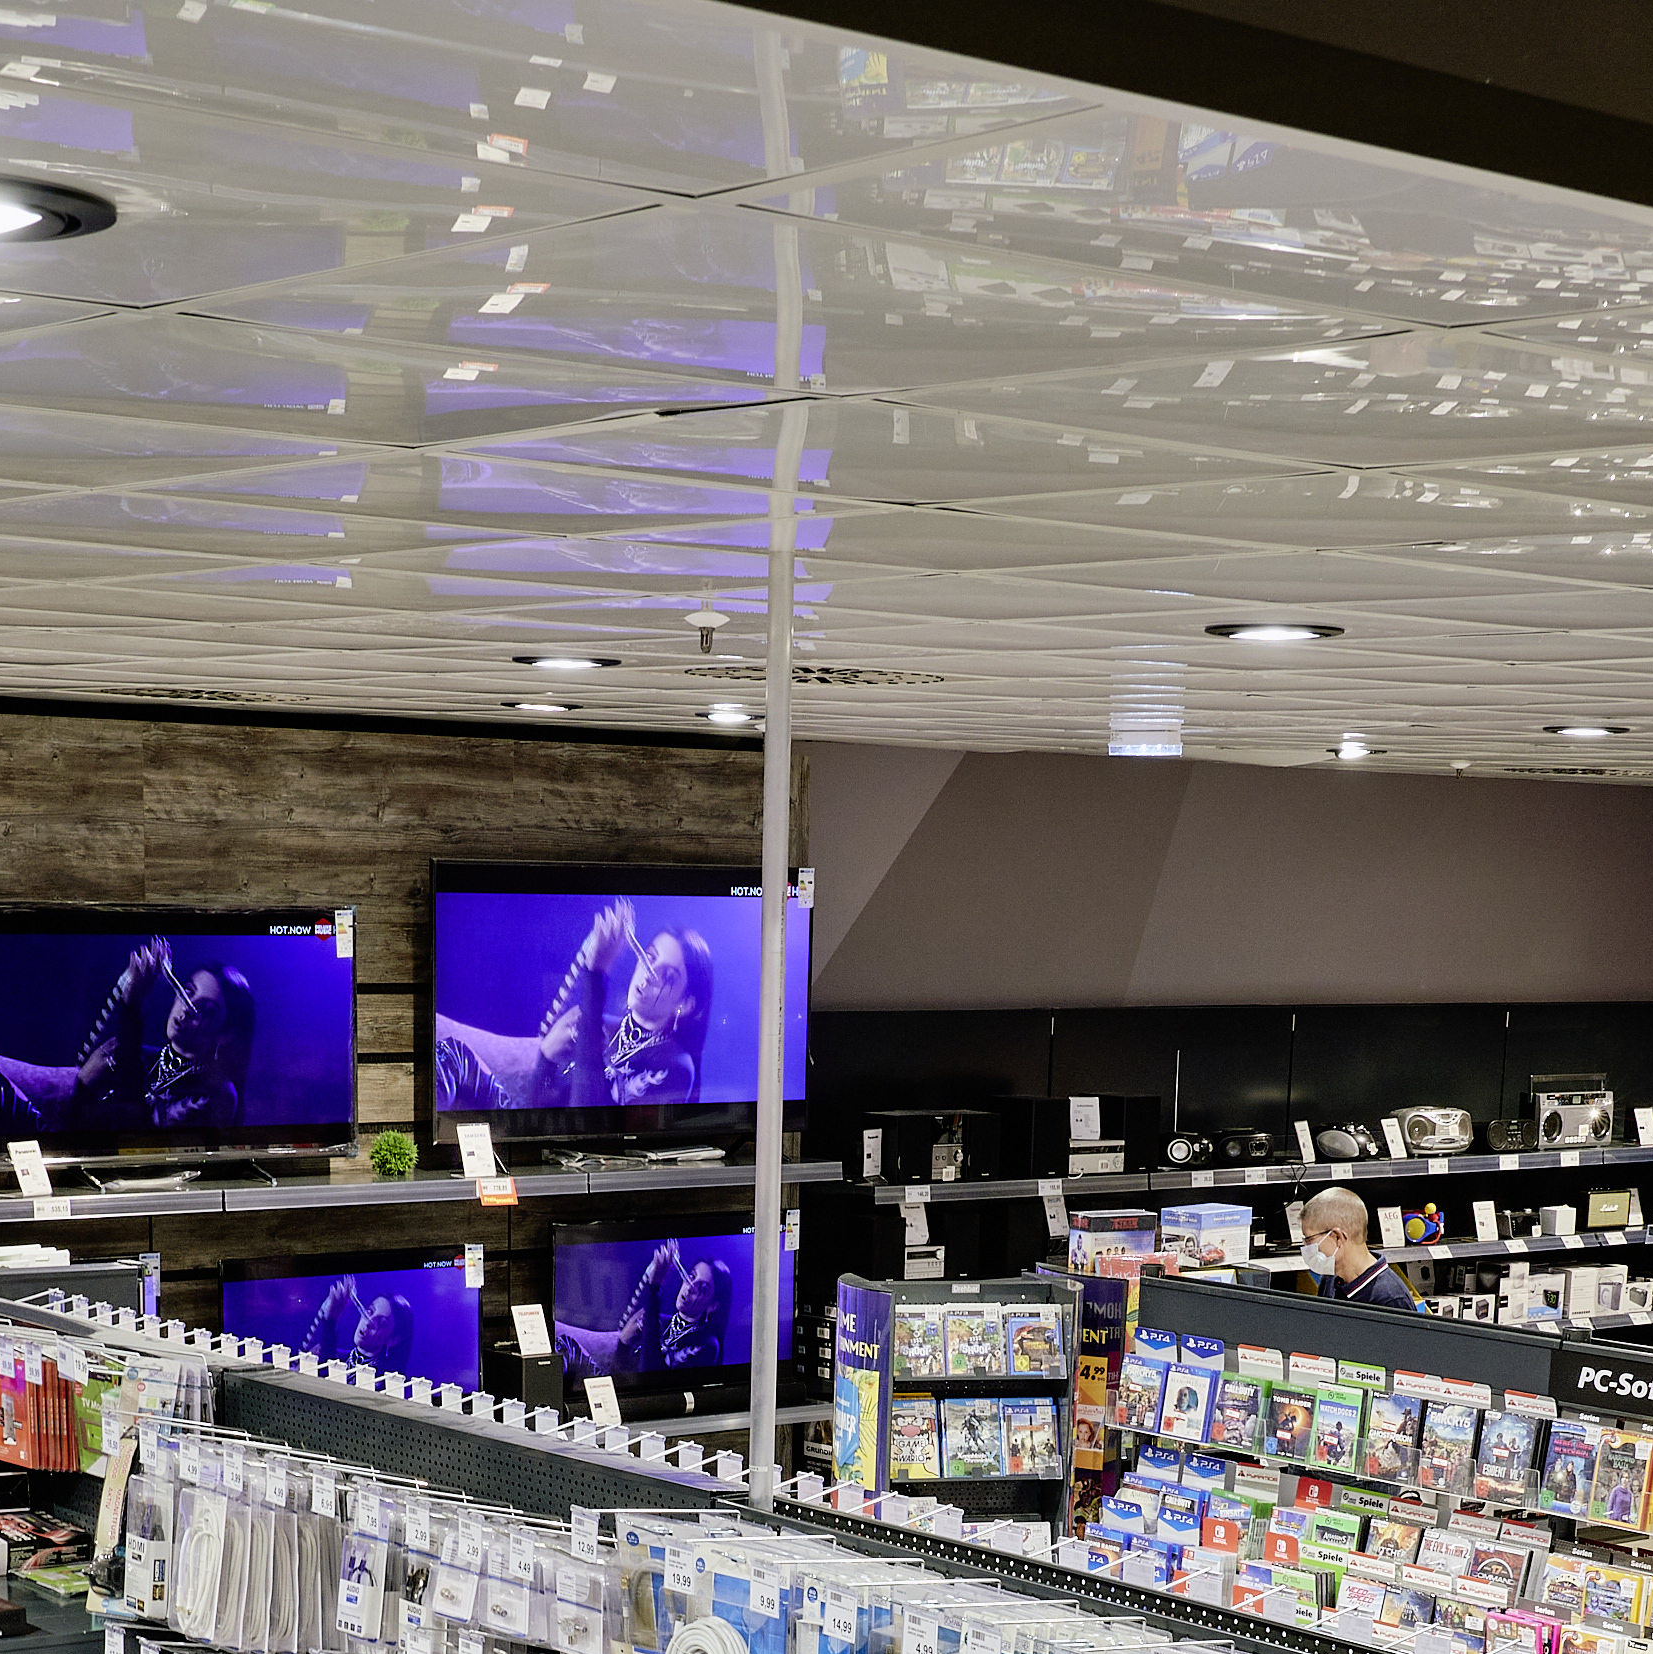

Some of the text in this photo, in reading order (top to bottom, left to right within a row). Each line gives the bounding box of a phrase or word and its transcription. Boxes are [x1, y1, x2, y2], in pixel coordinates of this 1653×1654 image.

[270, 926, 311, 936] HOT.NOW
[1383, 1210, 1400, 1221] AEG
[1150, 1333, 1171, 1346] PS4
[1356, 1371, 1381, 1386] Spiele
[1579, 1412, 1601, 1424] Serien
[577, 1540, 595, 1556] 12,99
[1571, 1547, 1594, 1559] Serien
[672, 1572, 692, 1588] 19,99
[760, 1595, 775, 1611] 9,99
[832, 1617, 852, 1634] 14,99
